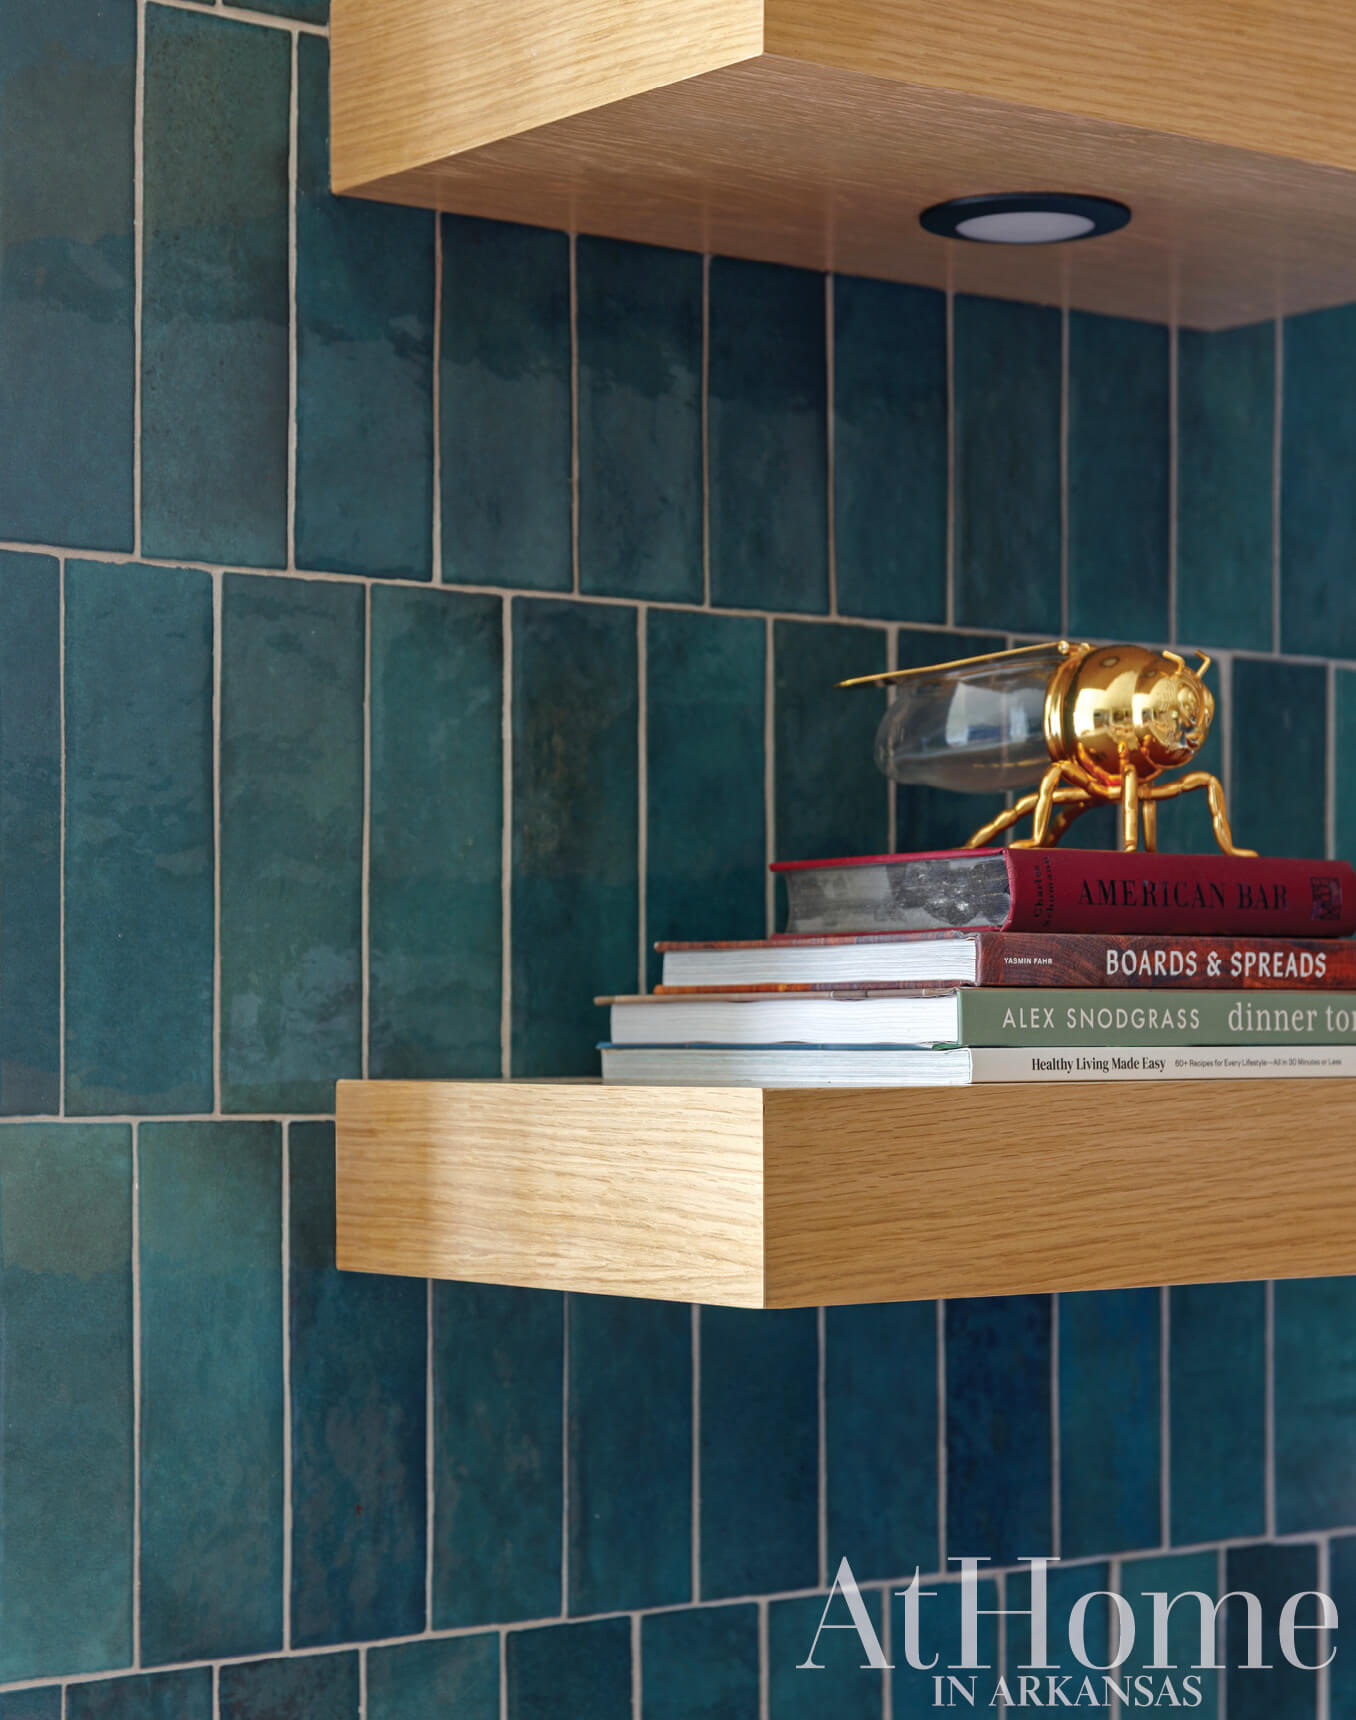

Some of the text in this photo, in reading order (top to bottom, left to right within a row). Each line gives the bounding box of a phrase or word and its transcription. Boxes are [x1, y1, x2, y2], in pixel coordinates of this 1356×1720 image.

[1077, 879, 1225, 909] AMERICAN
[1239, 882, 1288, 911] BAR
[1003, 956, 1032, 965] YASMIN
[1105, 949, 1327, 978] BOARDS & SPREADS
[1002, 1007, 1055, 1029] ALEX
[1067, 1007, 1200, 1030] SNODGRASS
[1228, 1001, 1318, 1032] dinner
[1031, 1056, 1166, 1074] Healthy Living Made Easy
[1175, 1060, 1188, 1068] 60+
[1189, 1059, 1213, 1069] Recipes
[1214, 1059, 1223, 1067] for
[1224, 1059, 1241, 1069] Every
[1298, 1058, 1321, 1066] Minutes
